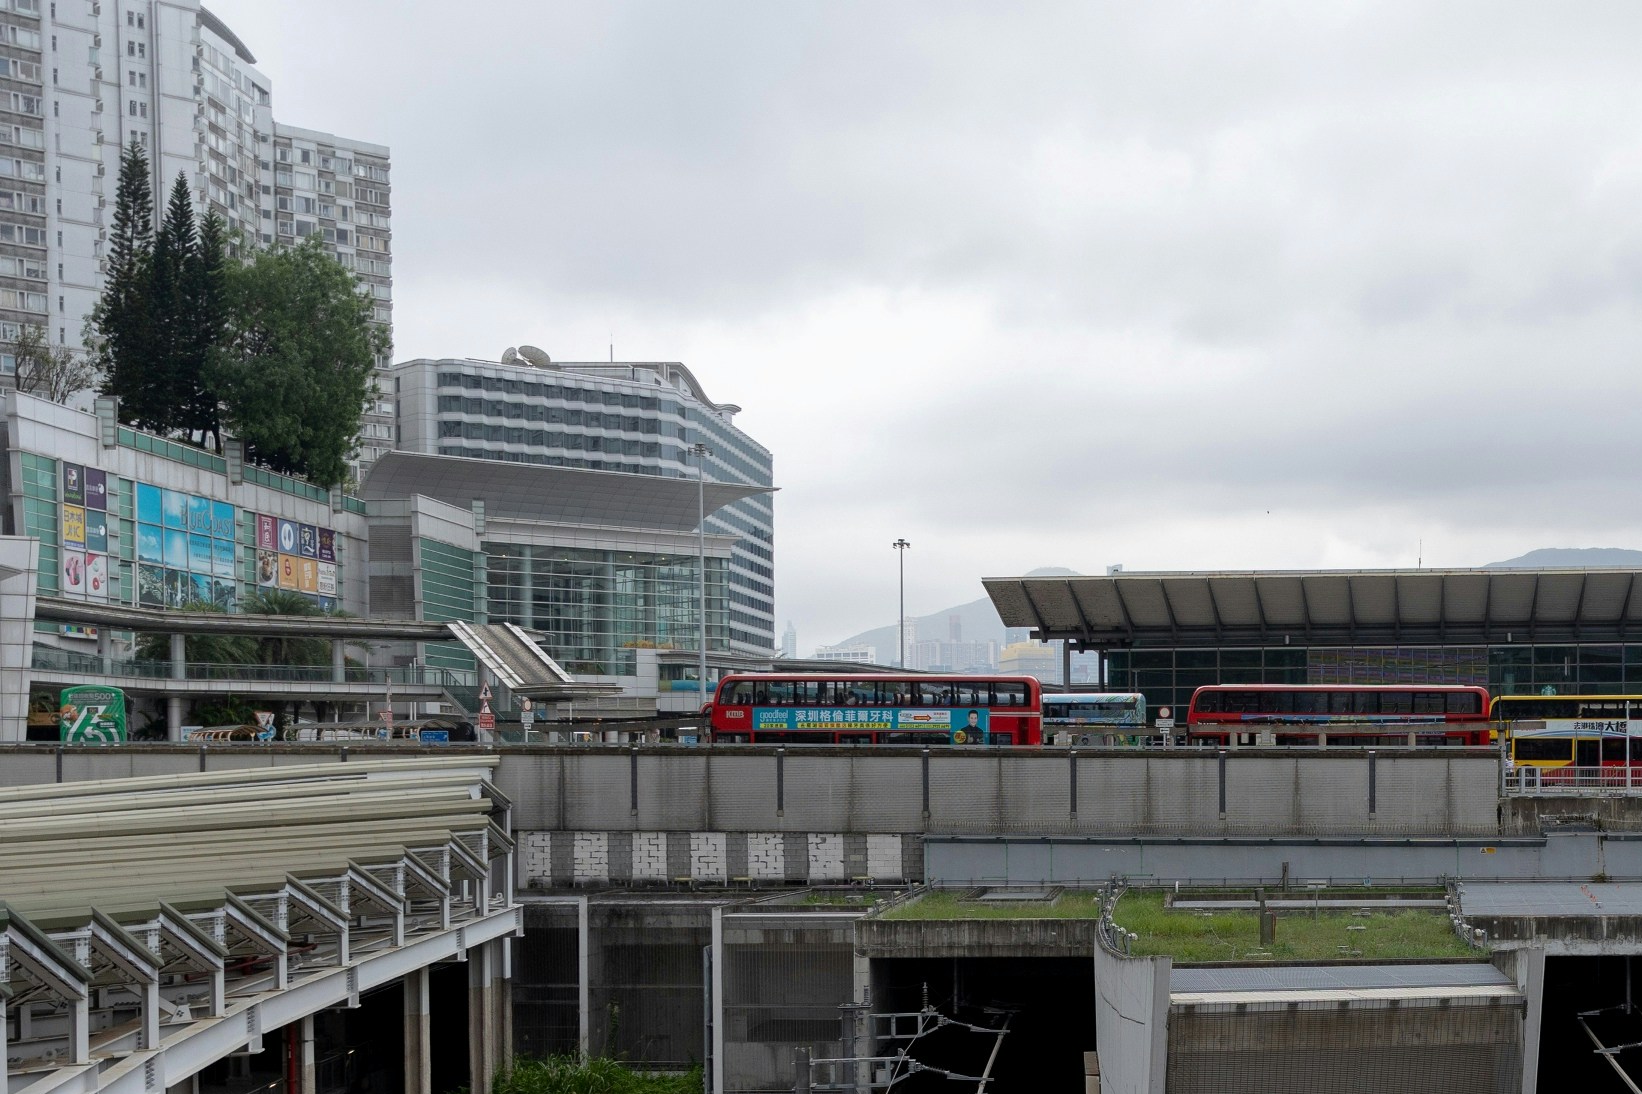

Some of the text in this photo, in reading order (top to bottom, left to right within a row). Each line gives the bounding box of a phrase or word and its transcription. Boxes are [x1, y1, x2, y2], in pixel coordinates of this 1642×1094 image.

[726, 710, 744, 718] KMB
[795, 710, 894, 722] 深圳格倫菲爾牙科
